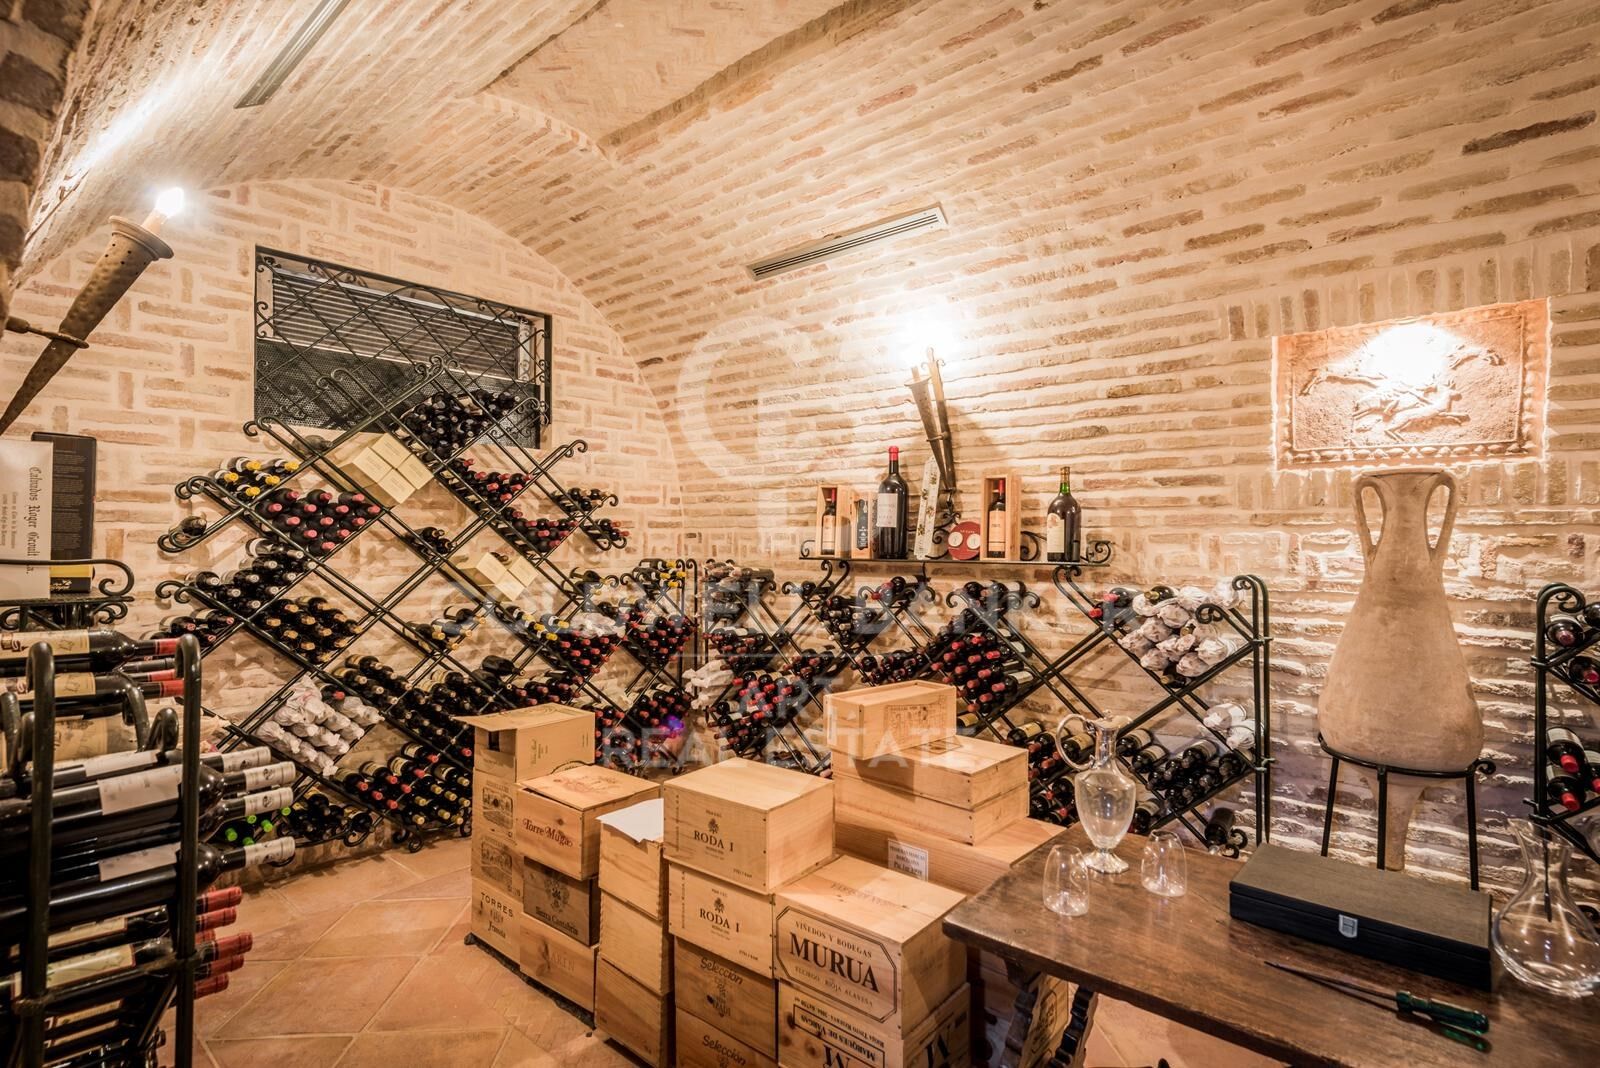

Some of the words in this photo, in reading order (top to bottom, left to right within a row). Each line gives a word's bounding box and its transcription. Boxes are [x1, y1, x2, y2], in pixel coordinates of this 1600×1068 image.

[28, 466, 42, 501] Calvados
[24, 504, 41, 529] Roger
[522, 818, 546, 835] Torre
[545, 825, 574, 847] Muga
[693, 829, 725, 850] RODA
[729, 842, 735, 852] I
[480, 891, 514, 918] TORRES
[699, 908, 731, 930] RODA
[735, 922, 740, 933] I
[836, 937, 873, 959] BODEGAS
[789, 931, 879, 993] MURUA
